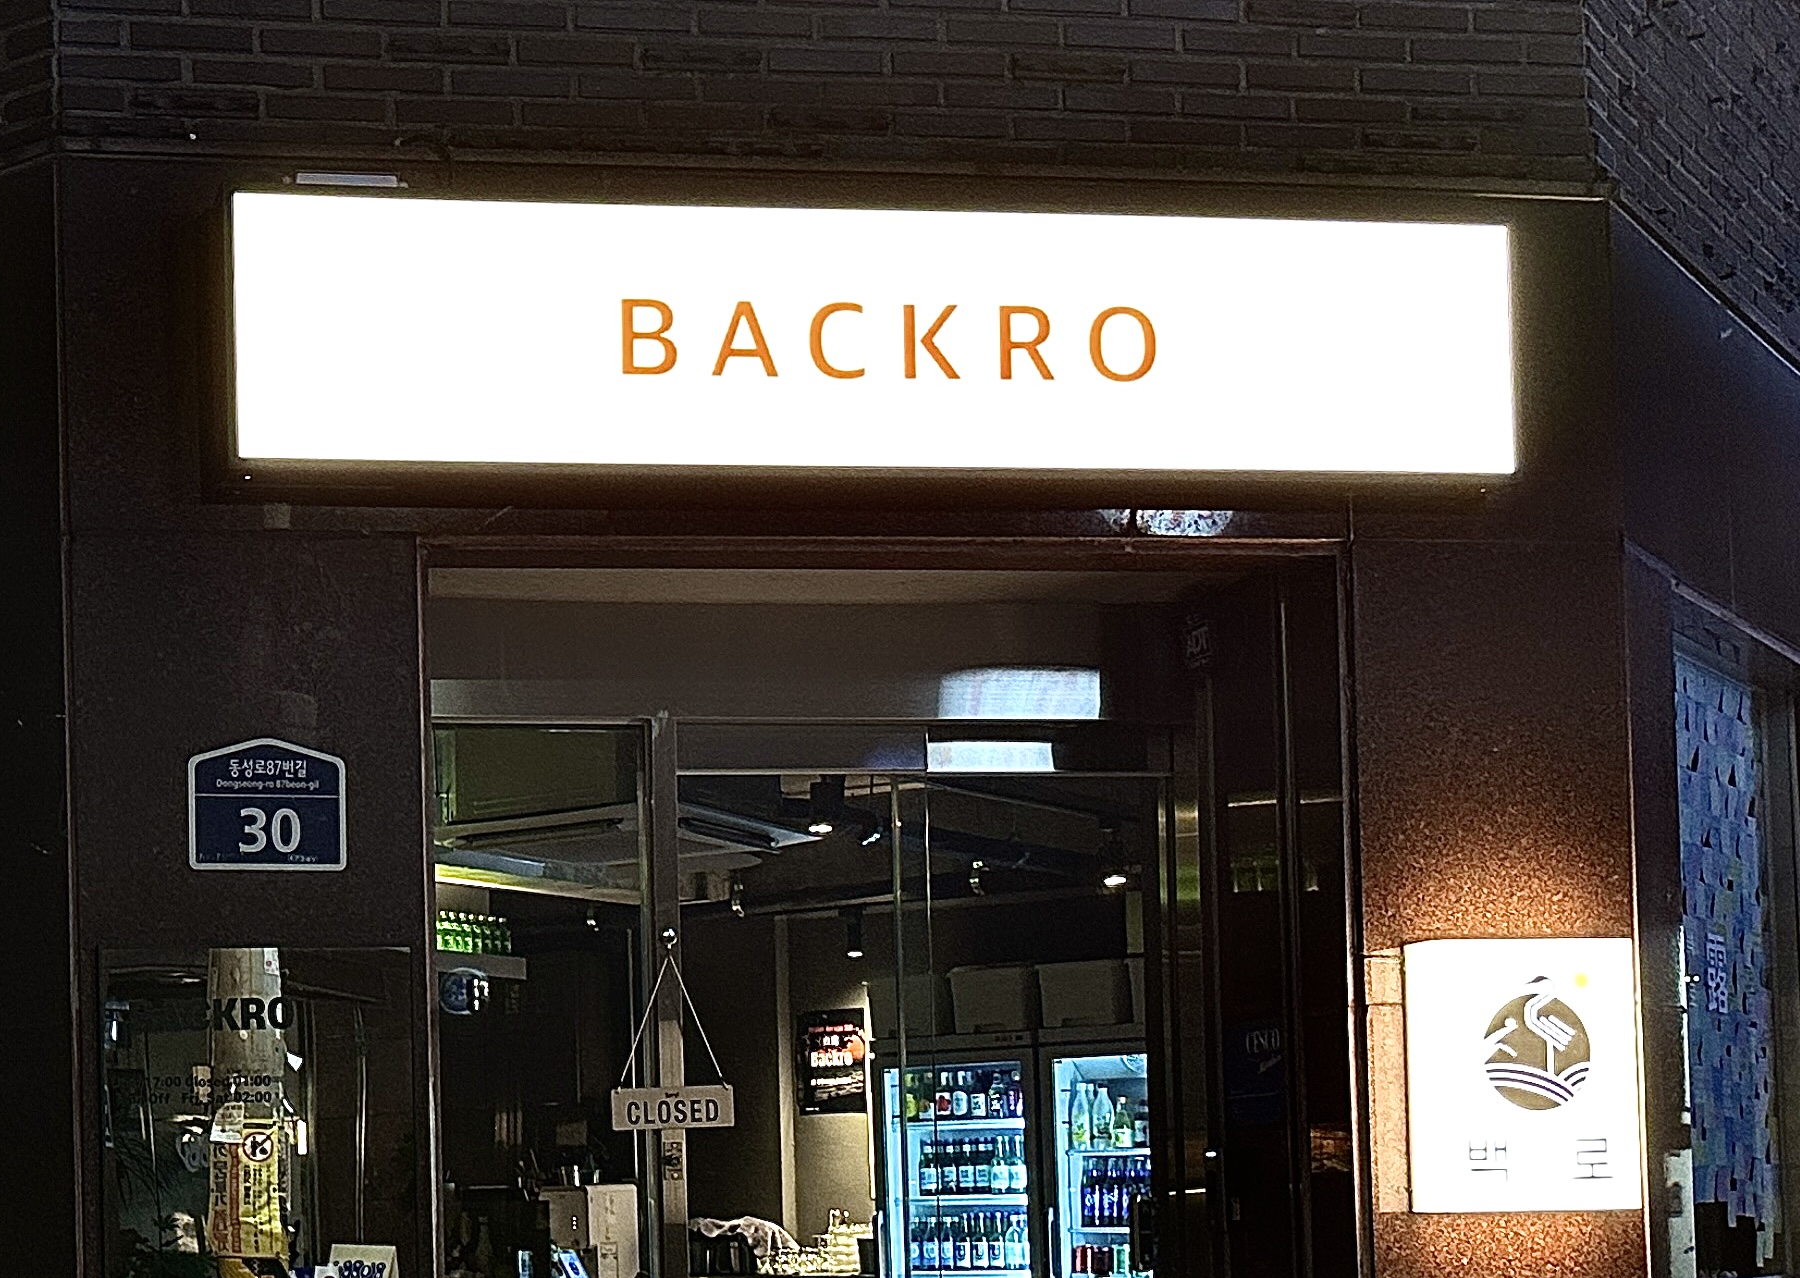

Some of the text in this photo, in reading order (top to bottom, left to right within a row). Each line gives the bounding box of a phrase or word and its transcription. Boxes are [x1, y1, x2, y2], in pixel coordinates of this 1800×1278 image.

[620, 297, 1158, 383] BACKRO
[228, 758, 308, 779] 동성로87번길
[216, 778, 275, 791] Dongseong-ro
[238, 806, 302, 854] 30
[809, 1050, 853, 1068] Backro
[233, 1091, 272, 1104] 02:00
[626, 1098, 719, 1126] CLOSED
